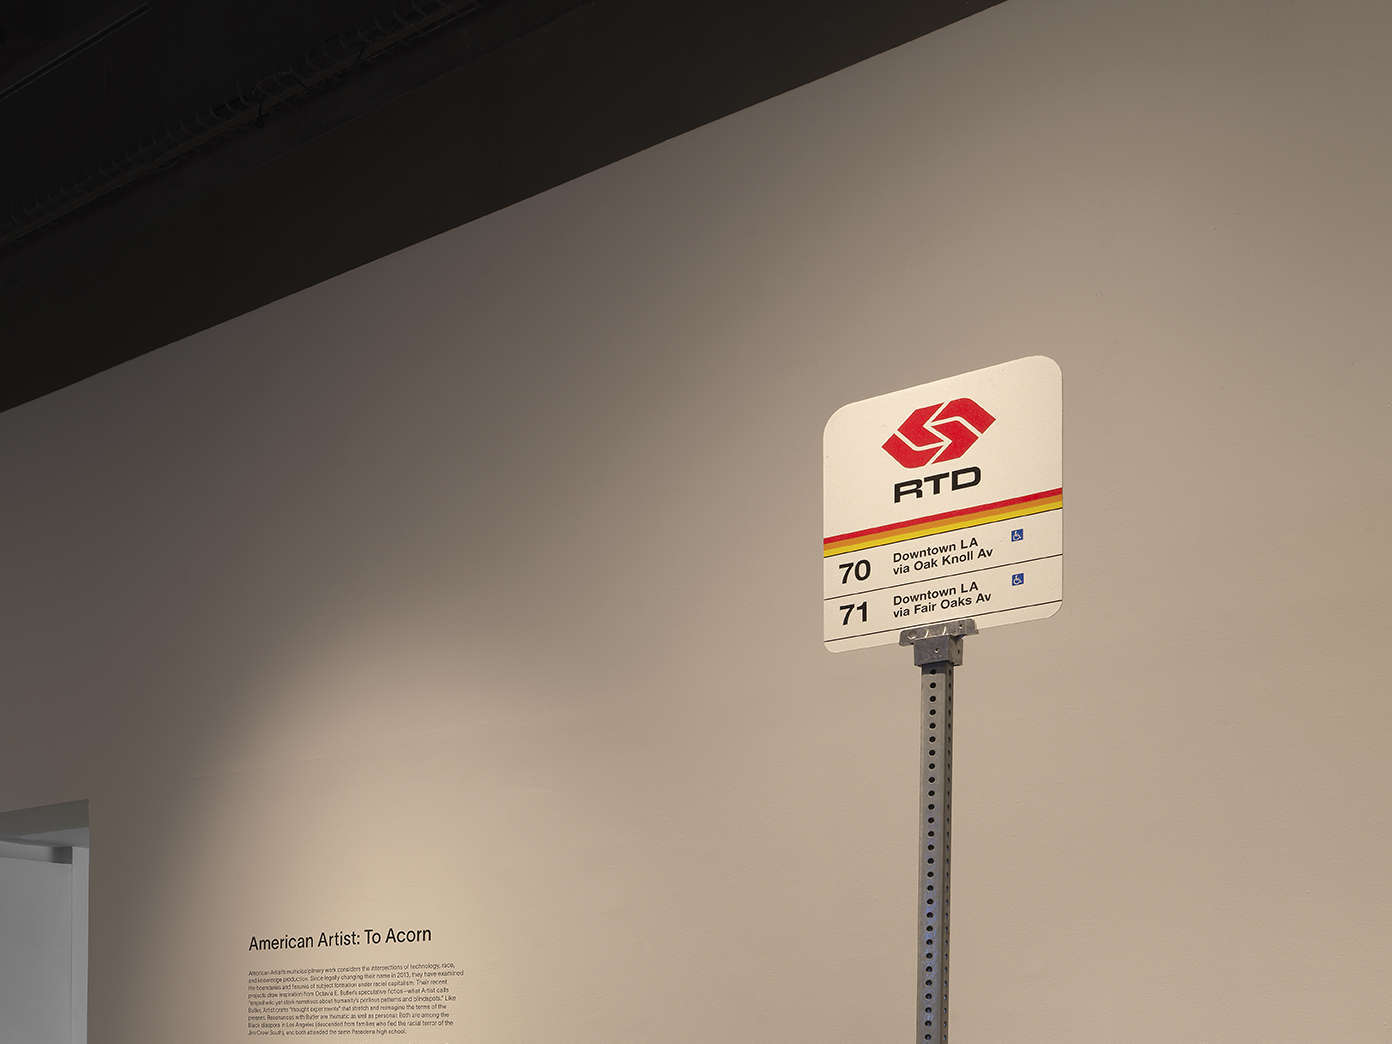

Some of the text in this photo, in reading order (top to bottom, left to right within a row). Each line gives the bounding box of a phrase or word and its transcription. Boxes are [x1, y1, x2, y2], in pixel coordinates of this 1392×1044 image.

[894, 466, 982, 504] RTD
[893, 538, 979, 563] Downtown LA
[893, 548, 993, 576] via Oak Knoll Av
[838, 559, 871, 585] 70
[893, 582, 979, 606] Downtown LA
[893, 593, 992, 619] via Fair Oaks Av
[839, 601, 868, 626] 71
[248, 927, 432, 951] American Artist: To Acorn
